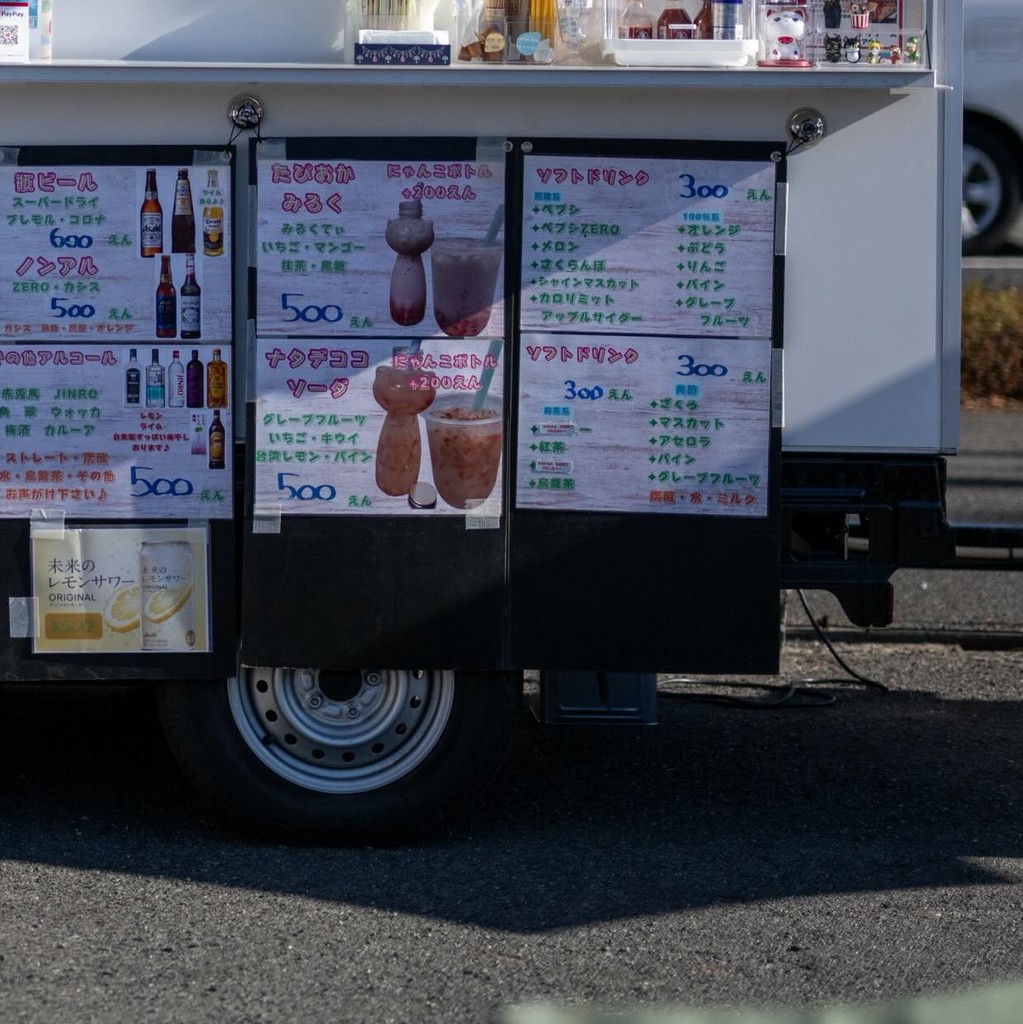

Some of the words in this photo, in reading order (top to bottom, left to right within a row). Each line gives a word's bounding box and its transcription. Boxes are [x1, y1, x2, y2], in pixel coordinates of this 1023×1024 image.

[1, 10, 24, 18] PayPay
[272, 163, 355, 184] たぴおか
[387, 163, 493, 178] にゃんこボトル
[14, 172, 98, 193] 瓶ビール
[537, 169, 649, 186] ソフトドリンク
[679, 174, 729, 198] 300
[747, 189, 771, 201] えん
[12, 196, 99, 209] スーパードライ
[282, 193, 342, 213] みるく
[542, 204, 581, 214] ペプシ
[542, 224, 620, 235] ペプシZERO
[688, 225, 741, 236] オレンジ
[49, 228, 93, 249] 600
[262, 241, 365, 253] いちご・マンゴー
[542, 242, 579, 251] メロン
[688, 243, 725, 254] ぶどう
[16, 256, 99, 276] ノンアル
[541, 260, 606, 271] さくらんぼ
[688, 262, 726, 272] りんご
[538, 278, 639, 290] シャインマスカット
[686, 279, 725, 290] パイン
[539, 294, 615, 305] カロリミット
[686, 298, 735, 309] グレープ
[51, 297, 95, 318] 500
[108, 309, 132, 319] えん
[281, 293, 343, 322] 500
[350, 317, 373, 327] えん
[541, 312, 642, 323] アップルサイダー
[700, 316, 749, 326] フルーツ
[266, 348, 369, 369] ナタデココ
[393, 354, 498, 368] にゃんこボトル
[526, 346, 639, 364] ソフトドリンク
[677, 355, 728, 376] 300
[743, 371, 766, 383] えん
[54, 389, 98, 399] JINRO
[287, 378, 349, 398] ソーダ
[564, 380, 604, 400] 300
[608, 389, 633, 400] えん
[660, 399, 699, 411] ざくろ
[51, 407, 101, 418] ウォッカ
[140, 412, 163, 420] レモン
[263, 414, 367, 426] グレープフルーツ
[660, 417, 725, 430] マスカット
[45, 426, 94, 436] カルーア
[269, 432, 360, 444] いちご・キウイ
[660, 436, 712, 447] アセロラ
[658, 454, 696, 465] パイン
[130, 466, 193, 497] 500
[200, 490, 223, 501] えん
[658, 472, 760, 485] グレープフルーツ
[278, 473, 336, 501] 500
[348, 496, 372, 506] えん
[48, 558, 95, 573] 未来の
[48, 576, 134, 589] レモンサワー
[49, 593, 96, 602] ORIGINAL
